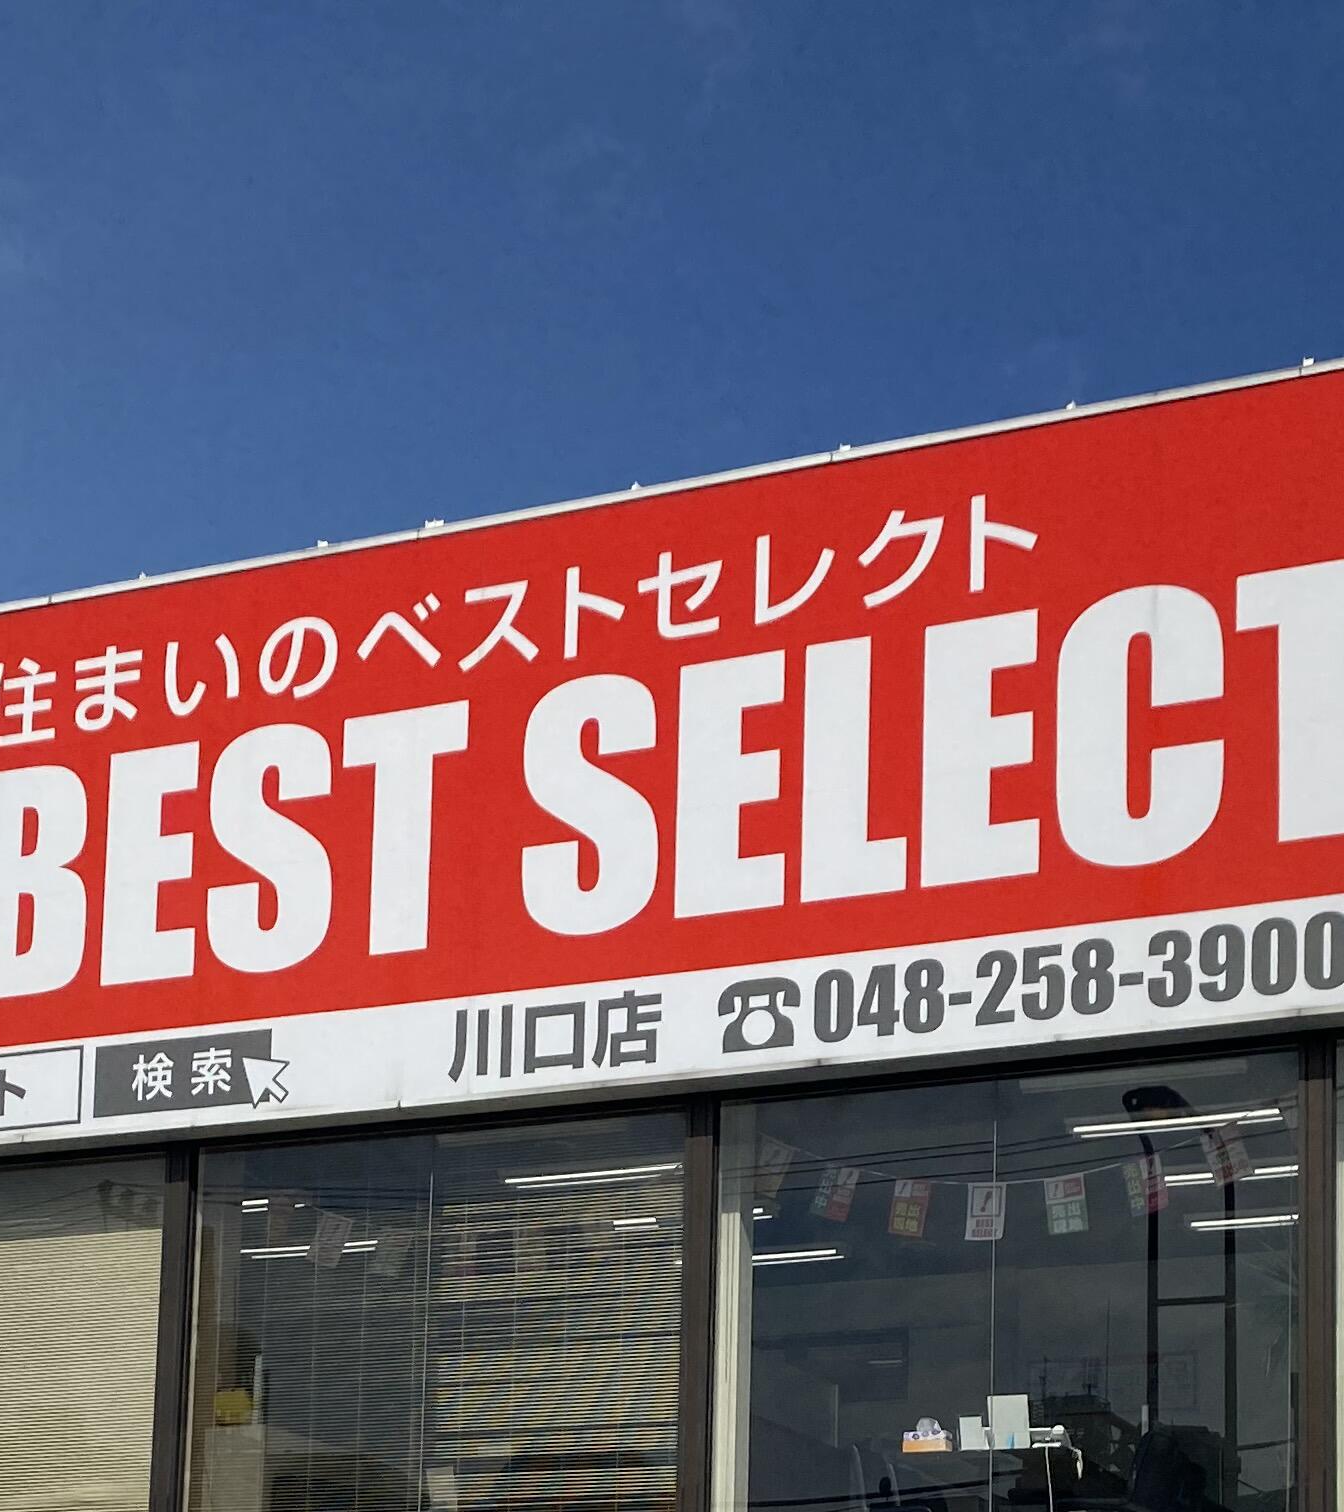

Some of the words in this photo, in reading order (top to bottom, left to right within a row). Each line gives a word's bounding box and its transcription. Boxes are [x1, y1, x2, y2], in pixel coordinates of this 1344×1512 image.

[449, 990, 663, 1083] 川口店
[131, 1047, 234, 1102] 検索
